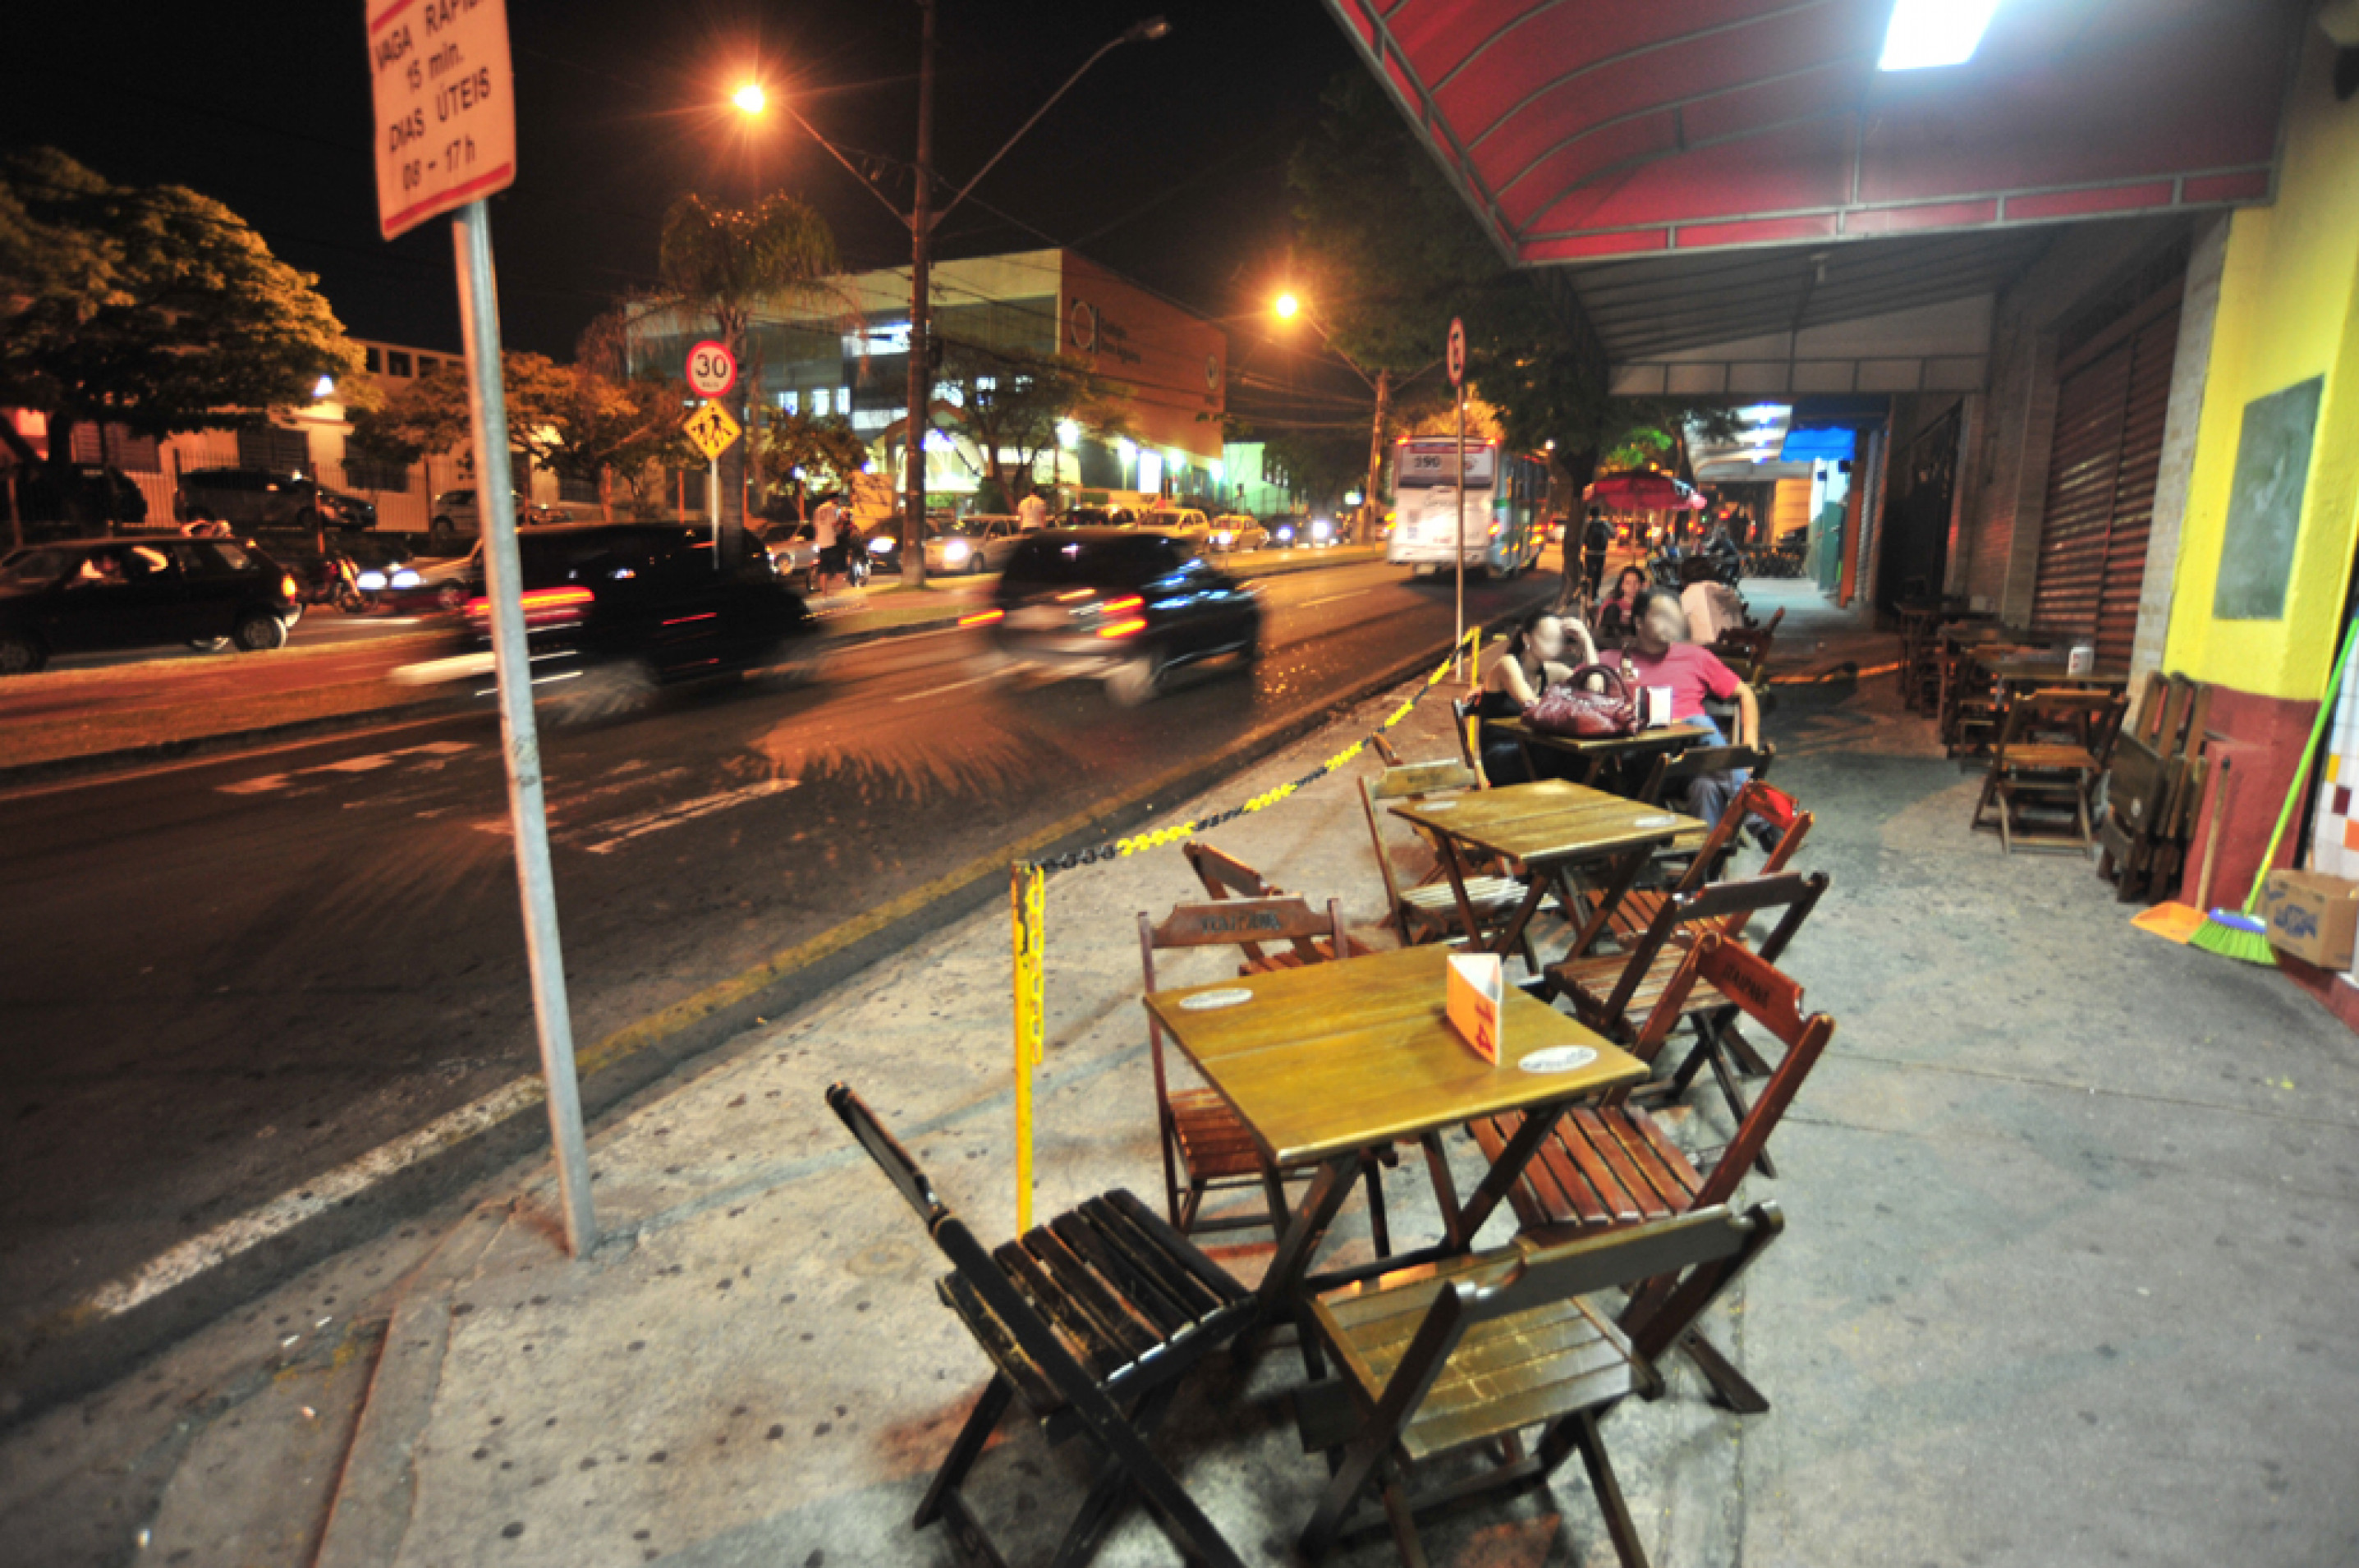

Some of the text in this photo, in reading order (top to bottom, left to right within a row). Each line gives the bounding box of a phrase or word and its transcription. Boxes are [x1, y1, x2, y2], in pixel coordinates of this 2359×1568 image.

[375, 23, 413, 71] VAGA
[407, 43, 463, 92] 15 min.
[389, 66, 490, 154] DIAS ÚTEIS
[403, 158, 421, 190] 08
[695, 354, 727, 378] 30
[1476, 1003, 1494, 1053] 14
